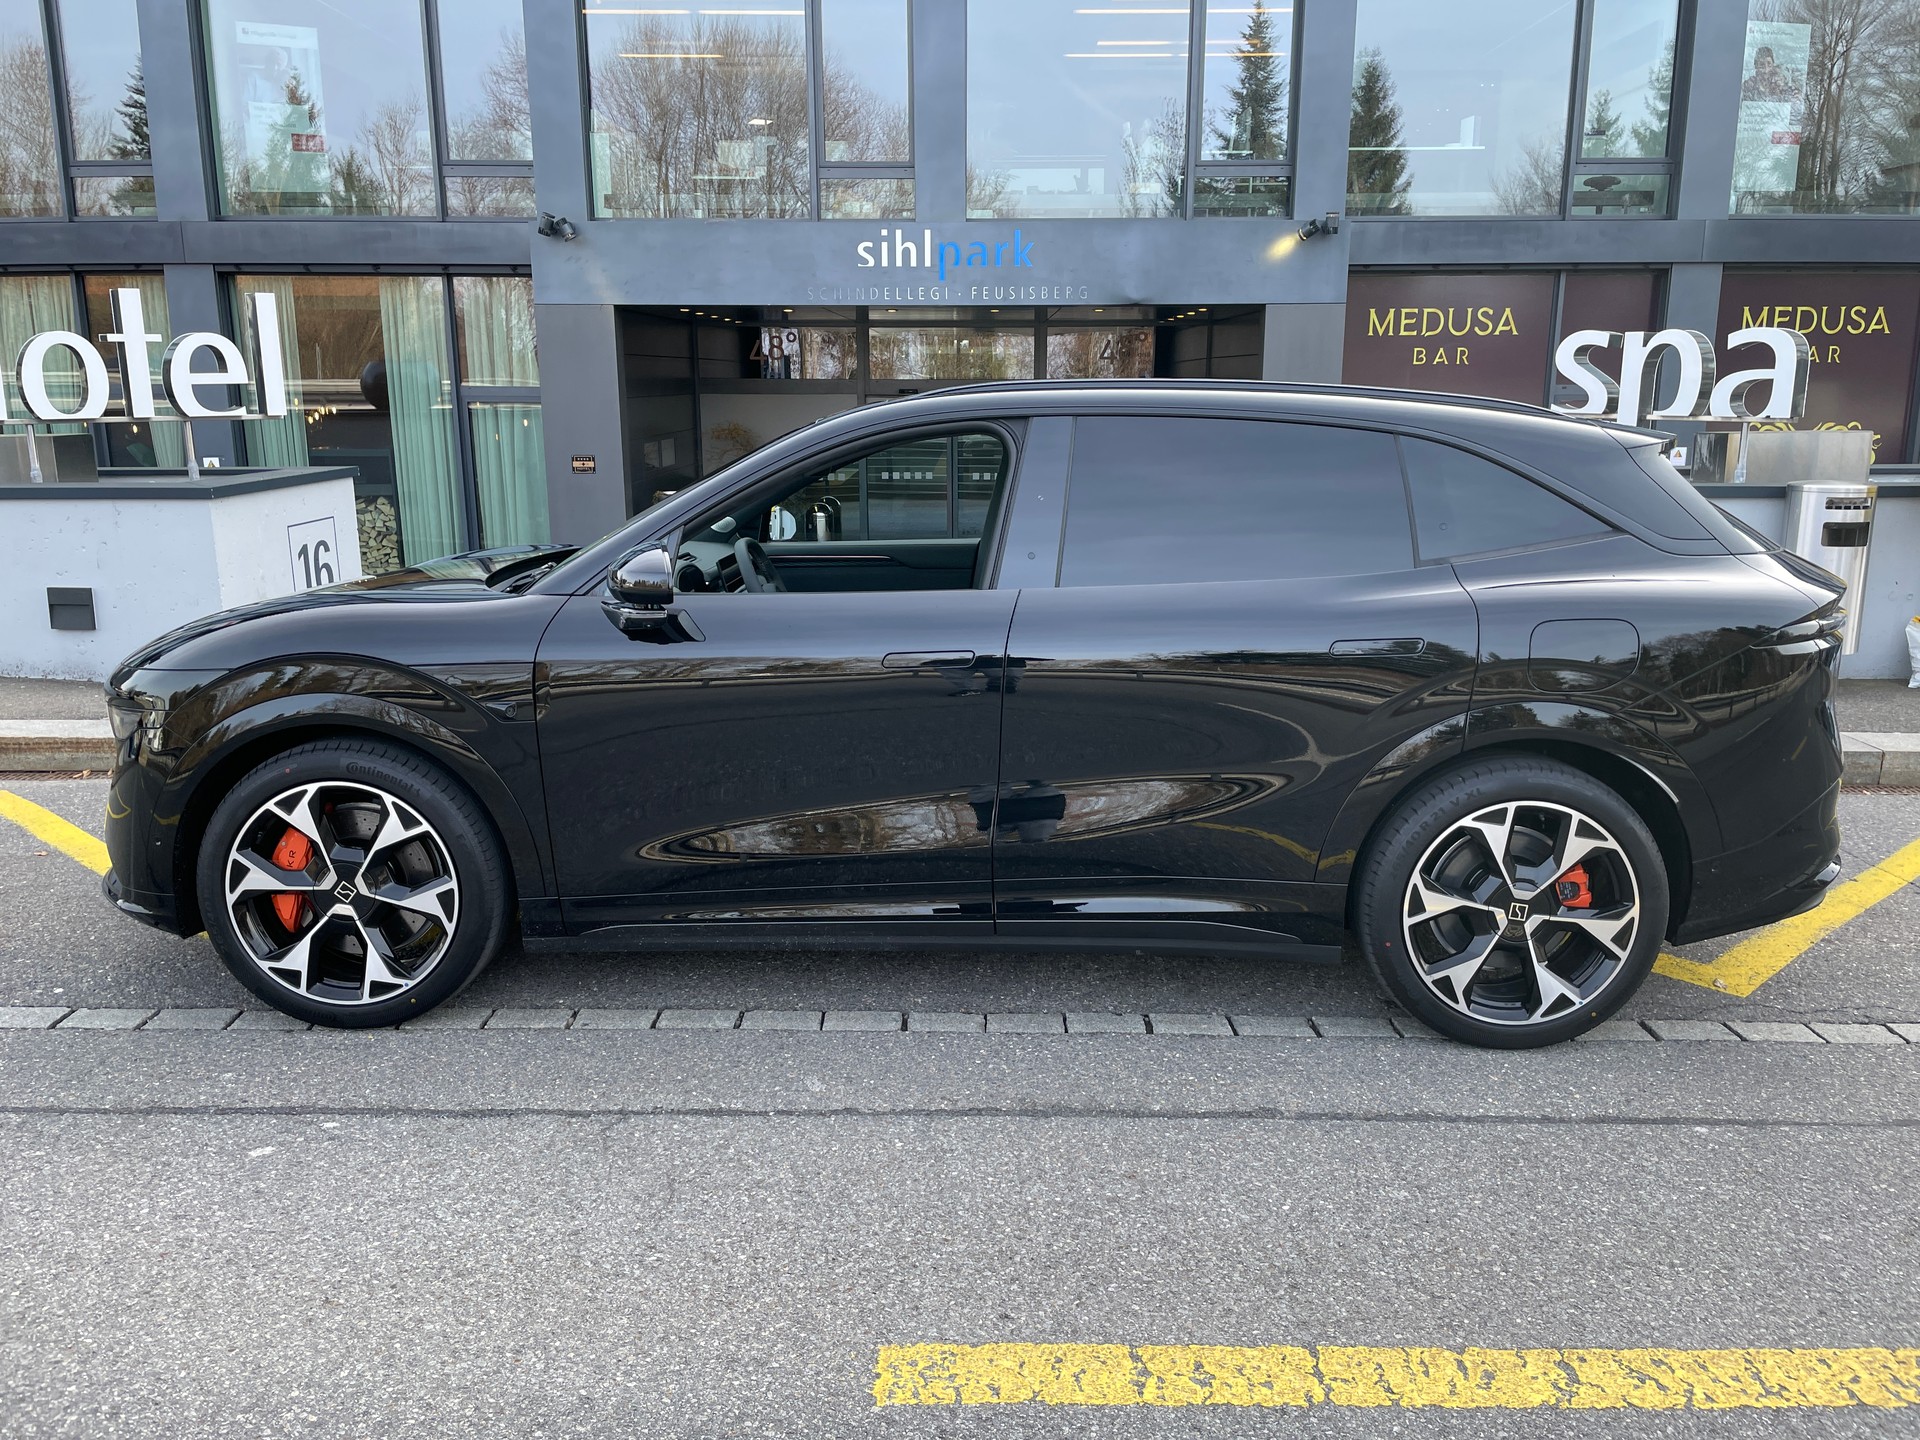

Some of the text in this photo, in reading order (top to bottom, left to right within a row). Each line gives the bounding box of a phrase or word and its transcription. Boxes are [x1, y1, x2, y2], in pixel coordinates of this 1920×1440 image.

[857, 229, 1035, 281] sihlpark
[807, 286, 1088, 300] SCHINDELLEGI FEUSISBERG
[1367, 307, 1519, 337] MEDUSA
[1741, 306, 1890, 335] MEDUSA
[1412, 347, 1469, 365] BAR
[1809, 345, 1841, 363] AR
[1551, 328, 1810, 427] spa
[298, 539, 335, 588] 16
[345, 761, 415, 794] Continental
